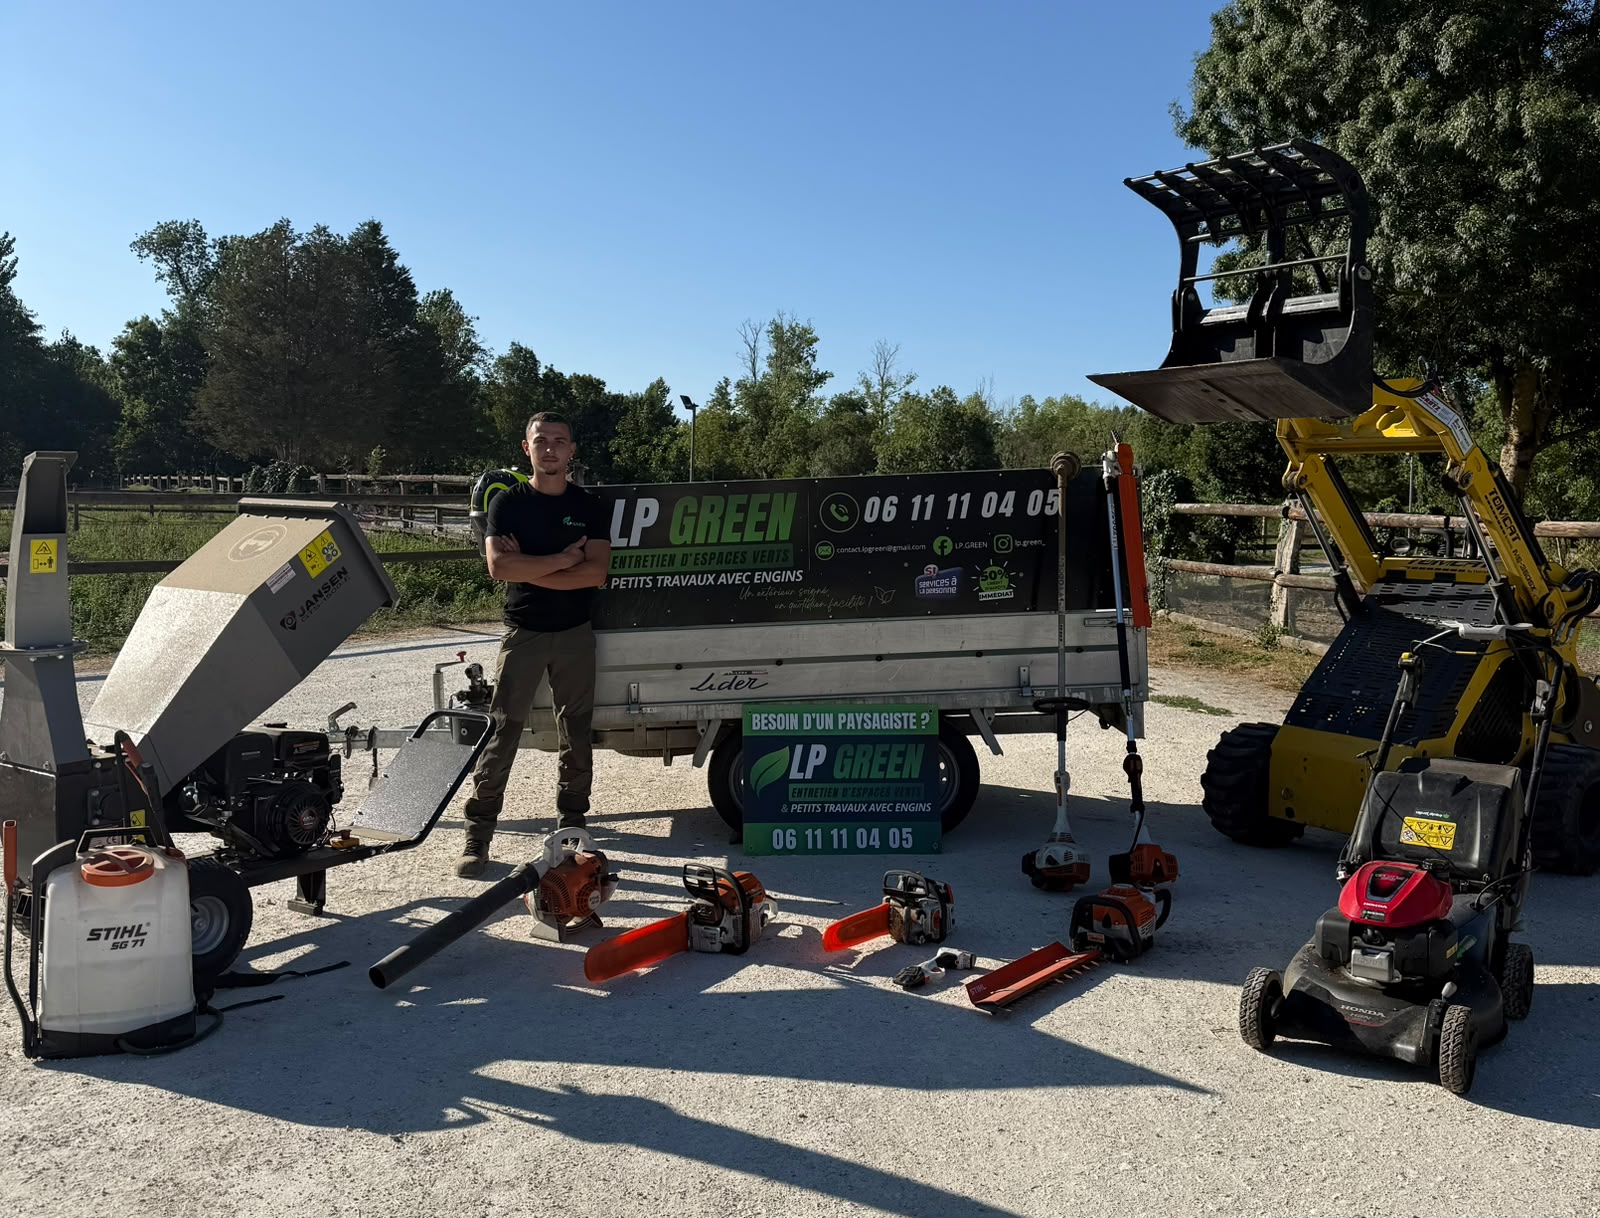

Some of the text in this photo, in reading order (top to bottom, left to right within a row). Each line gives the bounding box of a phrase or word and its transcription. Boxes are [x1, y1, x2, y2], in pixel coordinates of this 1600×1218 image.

[864, 489, 1060, 523] 06 11 11 04 05
[610, 492, 797, 547] LP GREEN
[1488, 488, 1521, 543] TOMCAT
[836, 543, 926, 554] contact.lpgreen@gmail.com
[954, 541, 988, 550] LP.GREEN
[611, 550, 790, 570] ENTRETIEN D'ESPACES VERTS
[611, 576, 653, 589] PETITS
[656, 573, 717, 587] TRAVAUX
[717, 571, 752, 585] AVEC
[753, 569, 804, 584] ENGINS
[919, 578, 950, 588] services
[981, 569, 1010, 582] 50%
[298, 566, 348, 618] JANSEN
[926, 586, 957, 595] personne
[979, 591, 1013, 600] IMMEDIAT
[690, 672, 769, 691] Lider
[751, 712, 930, 730] BESOIN D'UN PAYSAGISTE ?
[788, 743, 925, 780] LP GREEN
[791, 786, 839, 799] ENTRETIEN
[781, 802, 931, 813] & PETITS TRAVAUX AVEC ENGINS
[772, 827, 913, 850] 06 11 11 04 05
[86, 923, 148, 942] STIHL
[110, 938, 145, 950] SG 71
[969, 982, 987, 997] STIHL
[1339, 1004, 1386, 1018] HONDA
